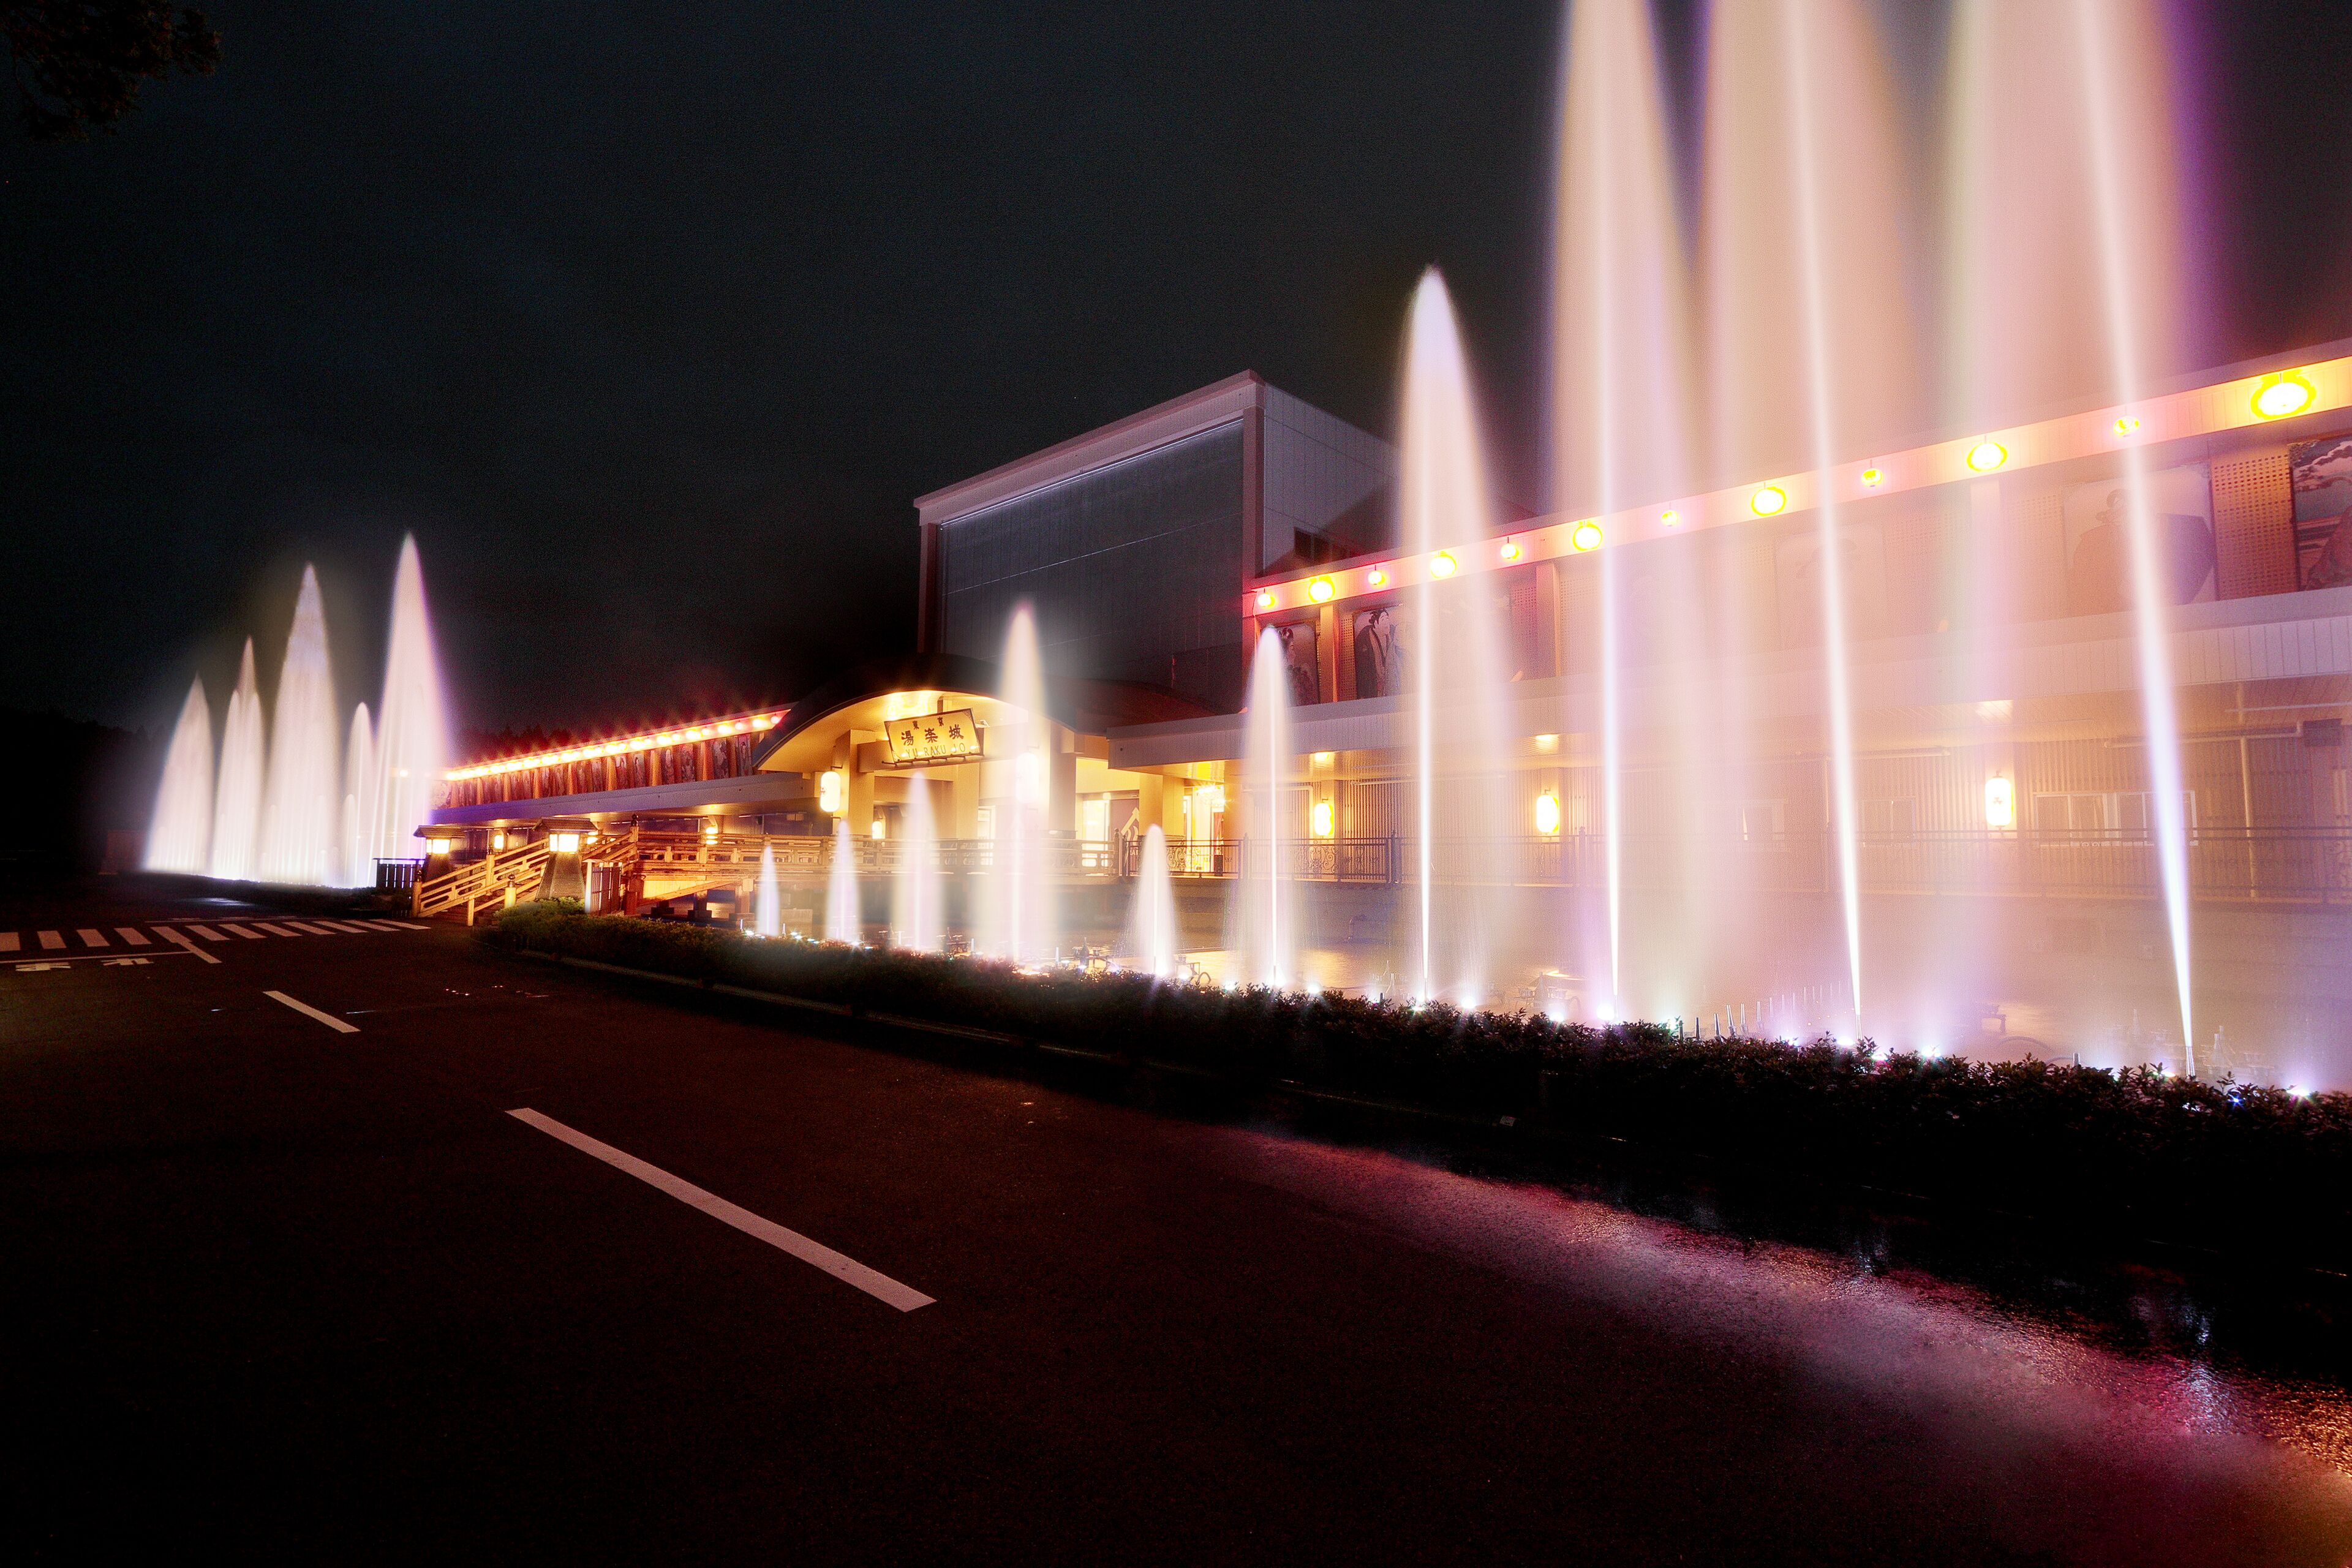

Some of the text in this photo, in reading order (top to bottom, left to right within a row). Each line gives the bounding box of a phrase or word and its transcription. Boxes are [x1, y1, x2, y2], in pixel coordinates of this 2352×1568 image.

[913, 717, 944, 729] 東京
[902, 724, 963, 745] 湯楽城
[905, 748, 918, 758] YU
[924, 744, 946, 756] RAKU
